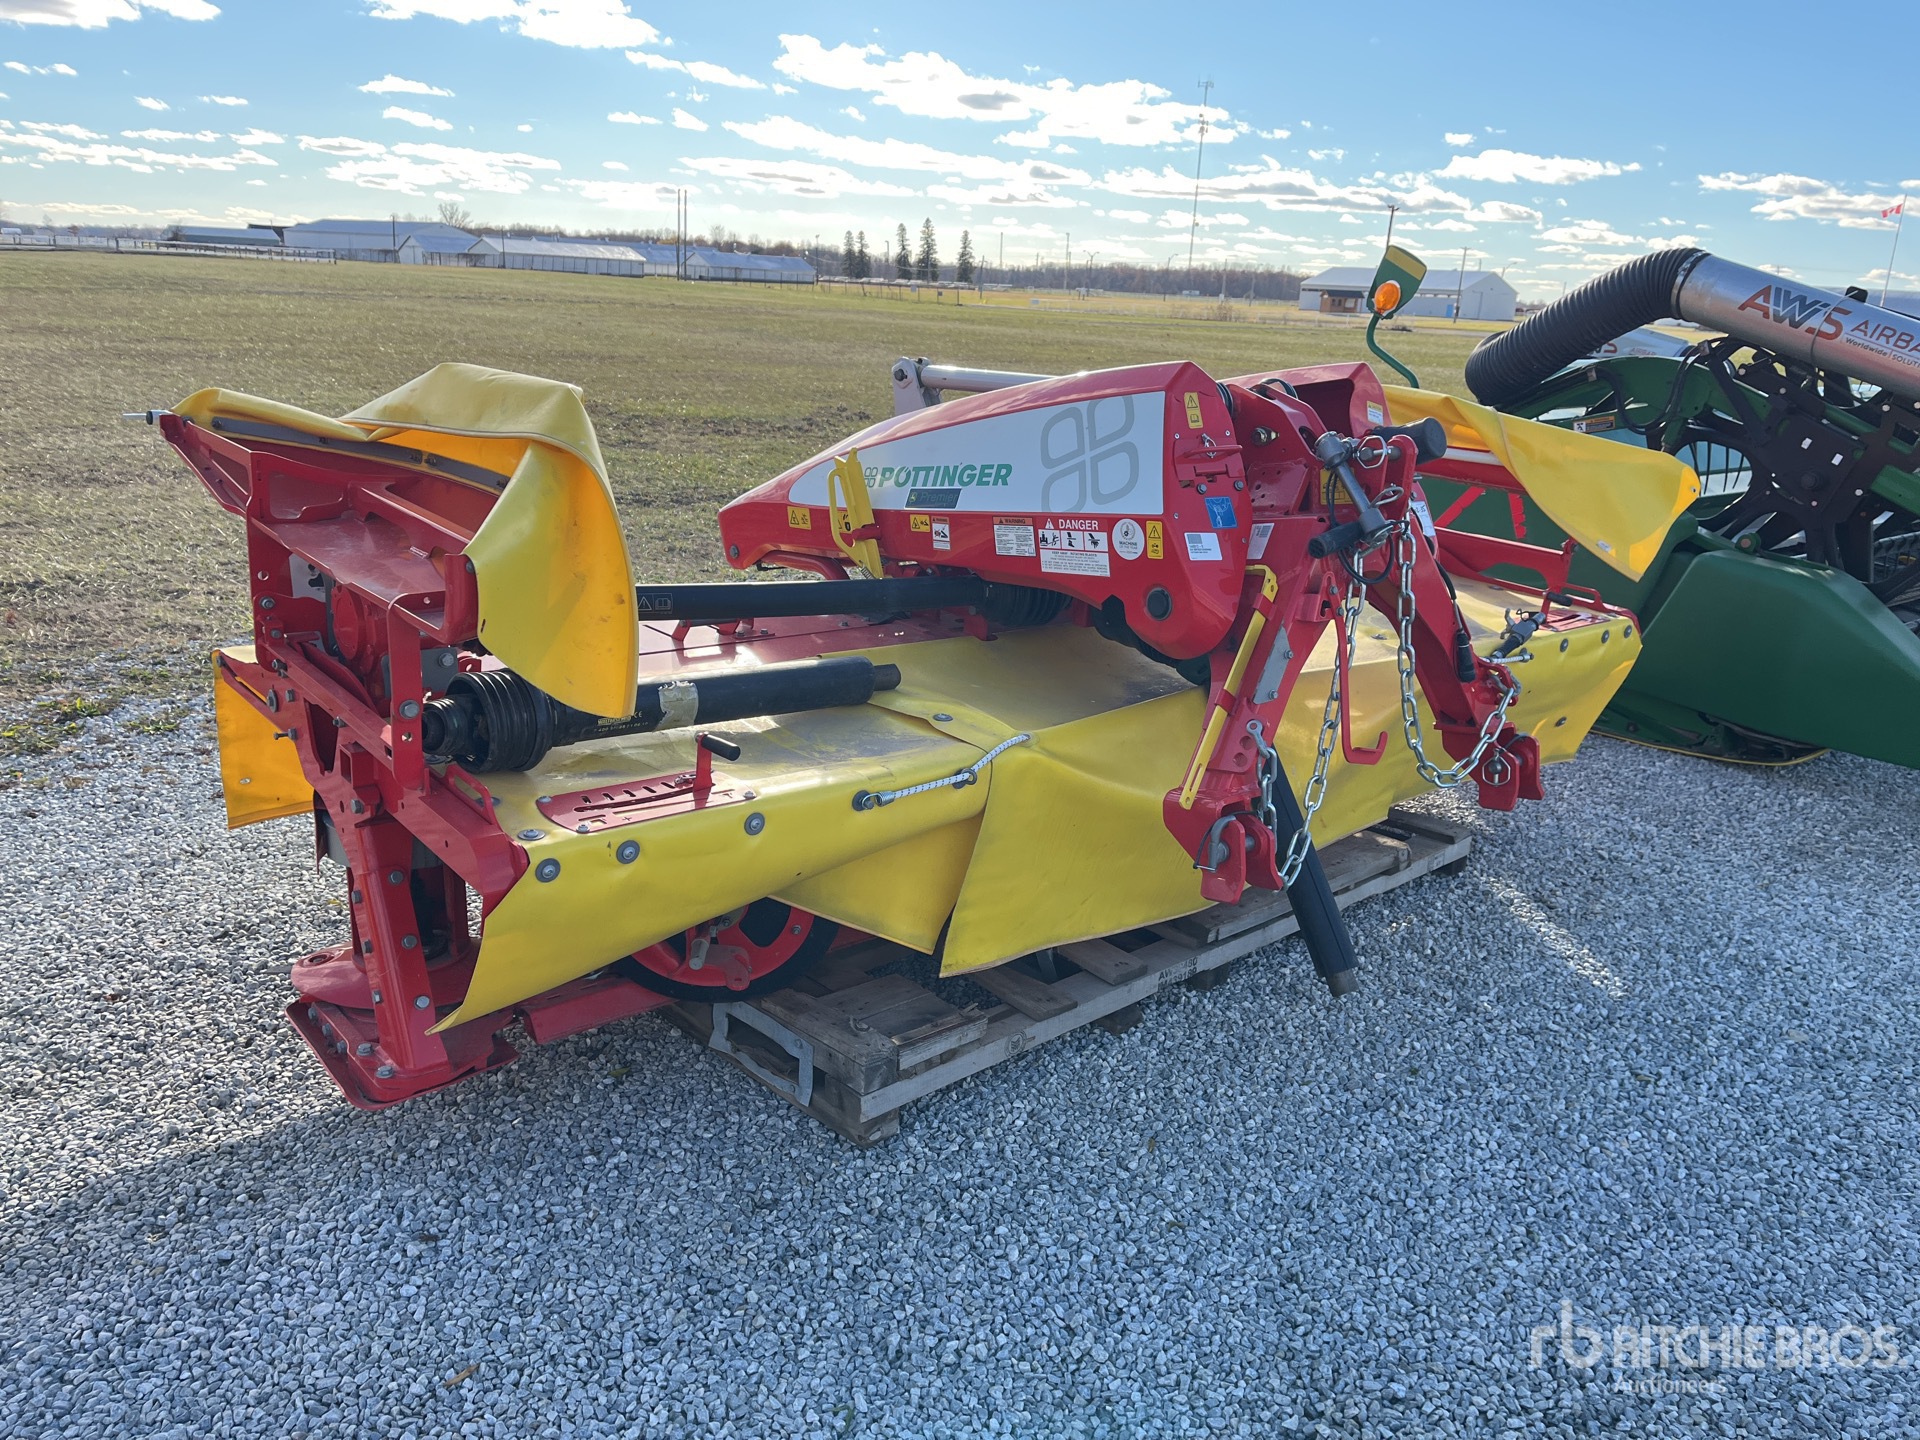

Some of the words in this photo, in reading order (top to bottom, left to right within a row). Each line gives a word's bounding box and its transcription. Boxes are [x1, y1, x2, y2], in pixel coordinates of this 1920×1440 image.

[1737, 284, 1853, 341] AWS
[1845, 336, 1888, 357] Worldwide
[920, 491, 959, 502] Premier
[1058, 519, 1099, 530] DANGER
